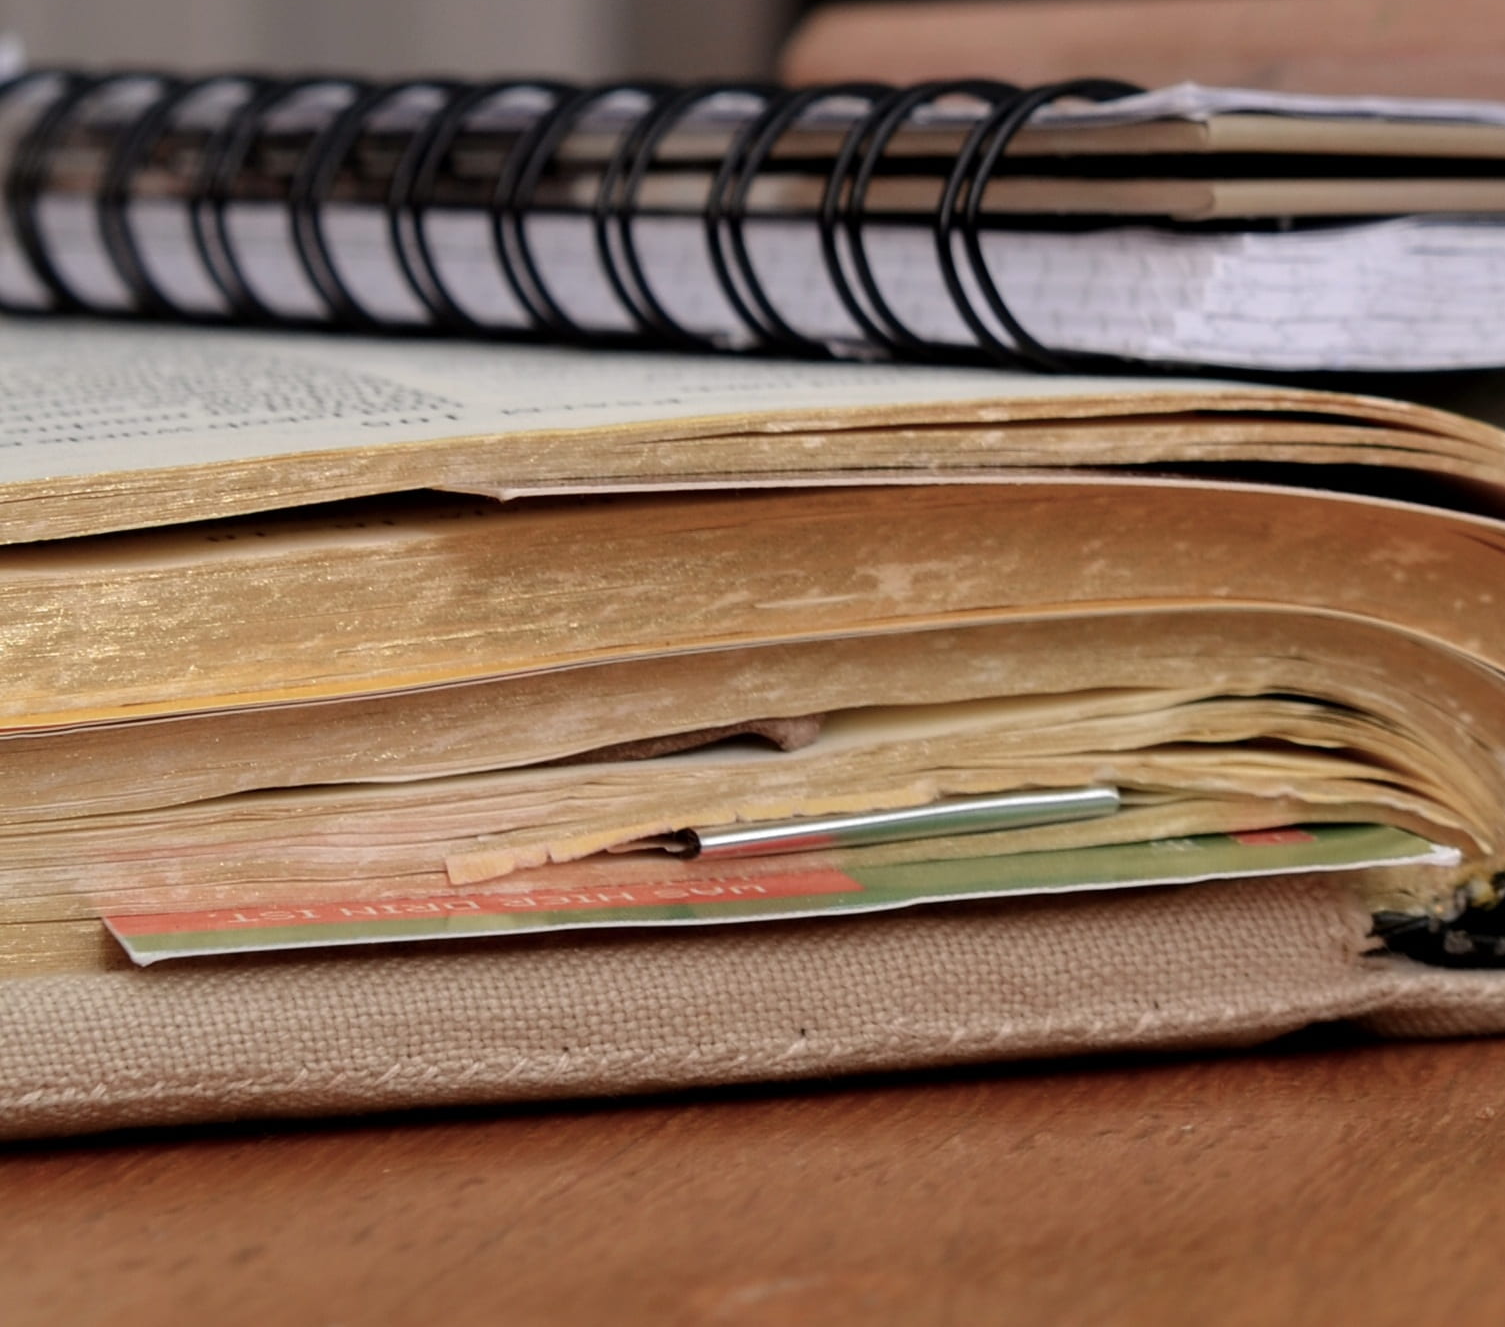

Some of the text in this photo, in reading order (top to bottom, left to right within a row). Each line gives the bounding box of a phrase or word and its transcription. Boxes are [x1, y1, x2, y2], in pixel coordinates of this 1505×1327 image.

[206, 884, 767, 924] WAS HIER DRIN IST.
